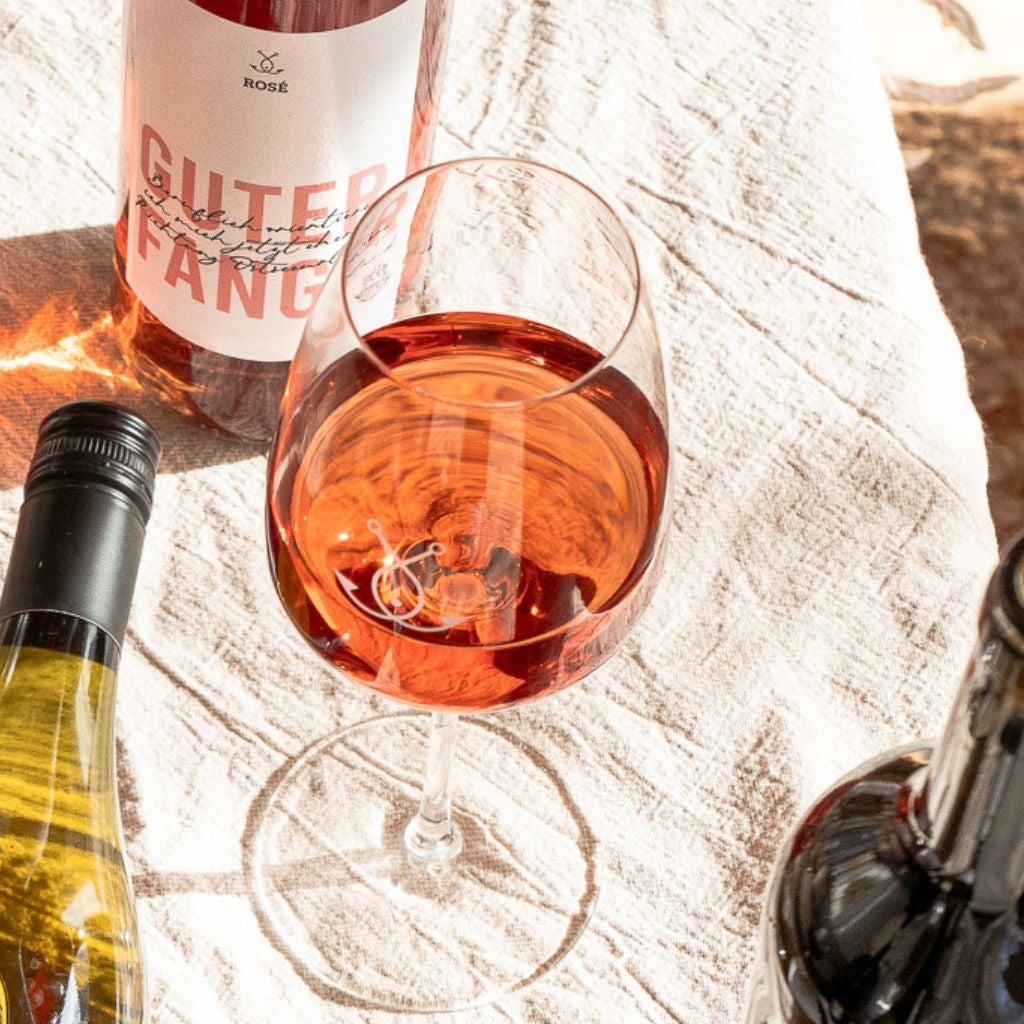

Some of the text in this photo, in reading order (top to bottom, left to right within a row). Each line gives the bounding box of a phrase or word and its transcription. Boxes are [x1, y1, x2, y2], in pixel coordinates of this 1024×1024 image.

[243, 77, 288, 94] ROSÉ
[141, 123, 396, 246] GUTER
[137, 203, 328, 320] FANG
